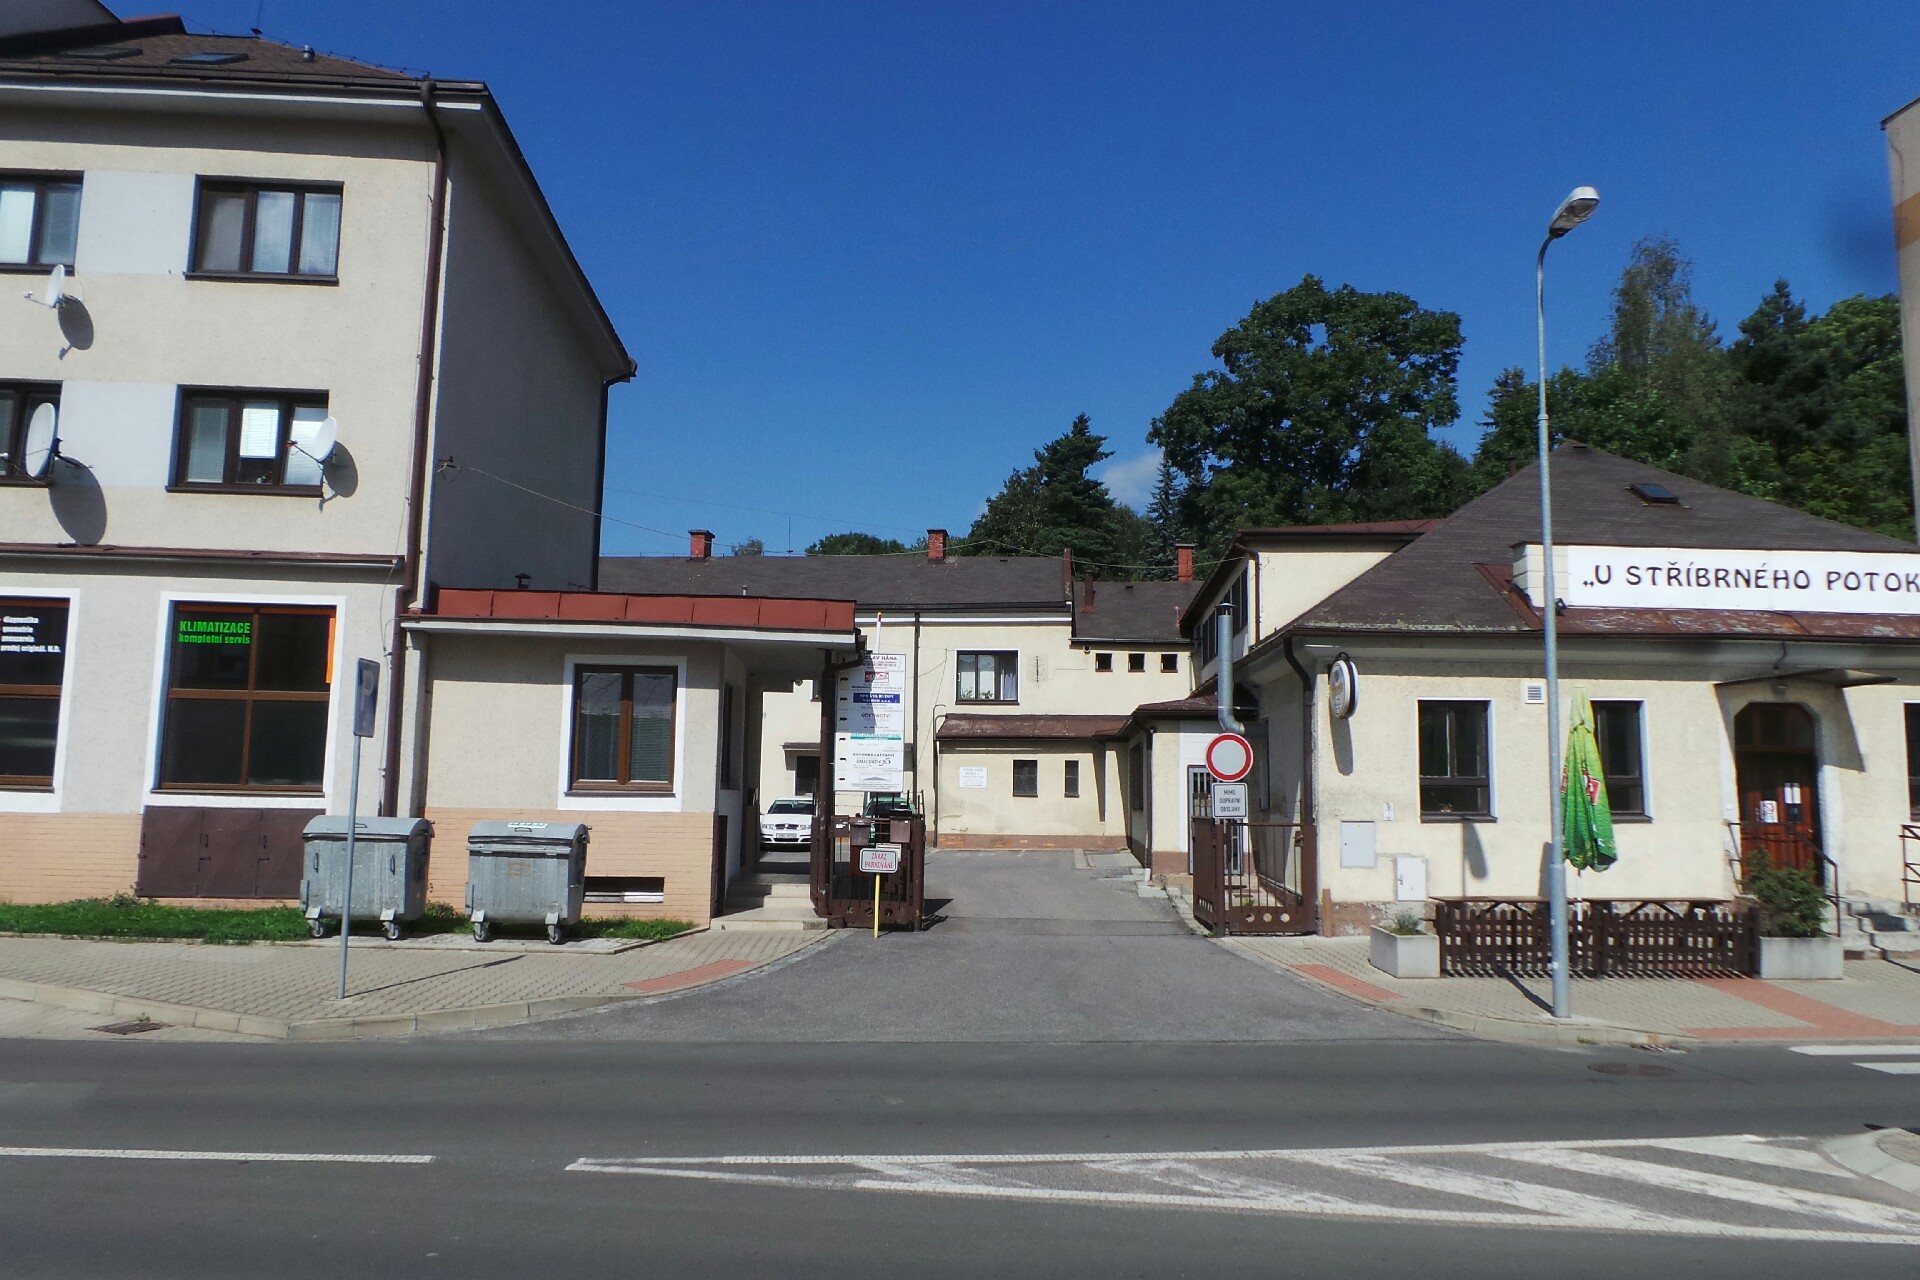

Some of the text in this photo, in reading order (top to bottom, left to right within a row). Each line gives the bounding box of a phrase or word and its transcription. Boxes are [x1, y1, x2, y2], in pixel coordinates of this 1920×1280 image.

[1626, 561, 1811, 591] STŘÍBRNÉHO
[1826, 570, 1920, 593] POTOK
[179, 620, 251, 634] KLIMATIZACE
[178, 633, 251, 644] kompletní servis
[864, 861, 893, 869] PARKOVÁNÍ
